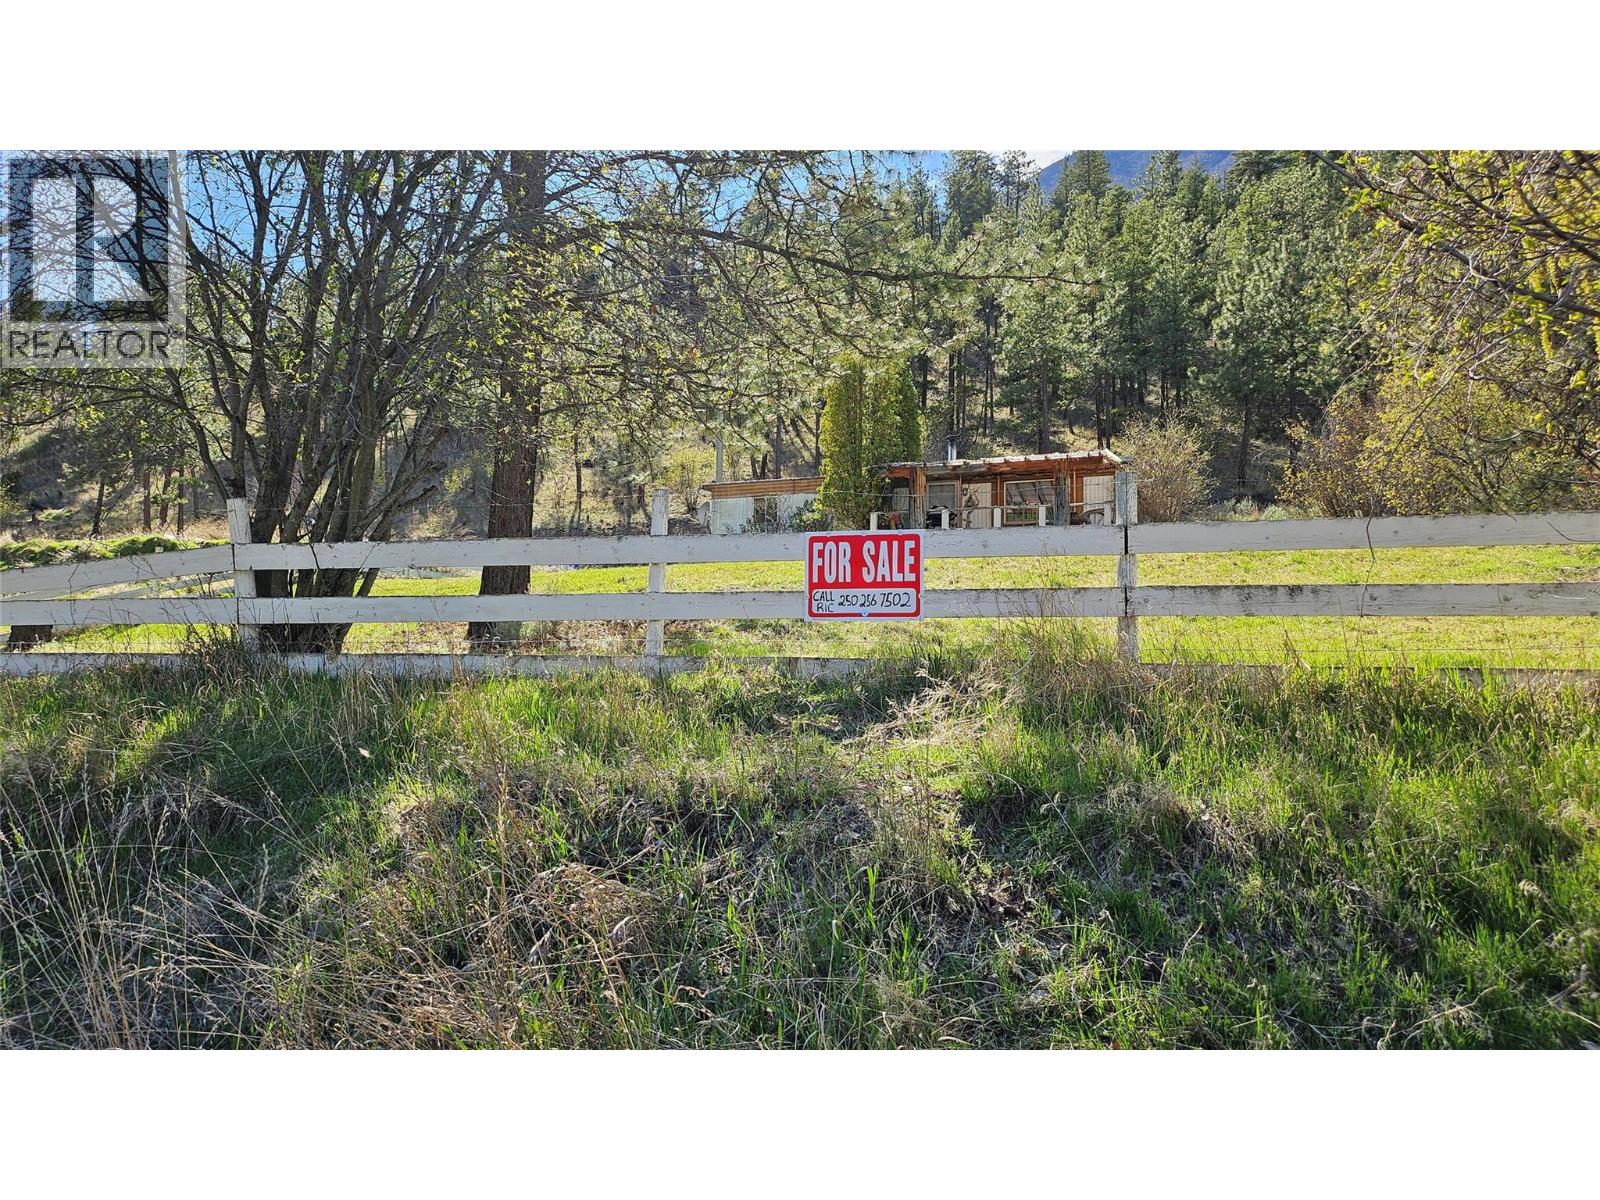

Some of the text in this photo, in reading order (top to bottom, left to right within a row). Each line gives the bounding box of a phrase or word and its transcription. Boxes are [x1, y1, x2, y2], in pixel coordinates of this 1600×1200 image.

[813, 540, 916, 583] FOR SALE
[813, 591, 835, 602] CALL
[838, 592, 912, 608] 250 256 7502
[816, 602, 834, 613] RIC
